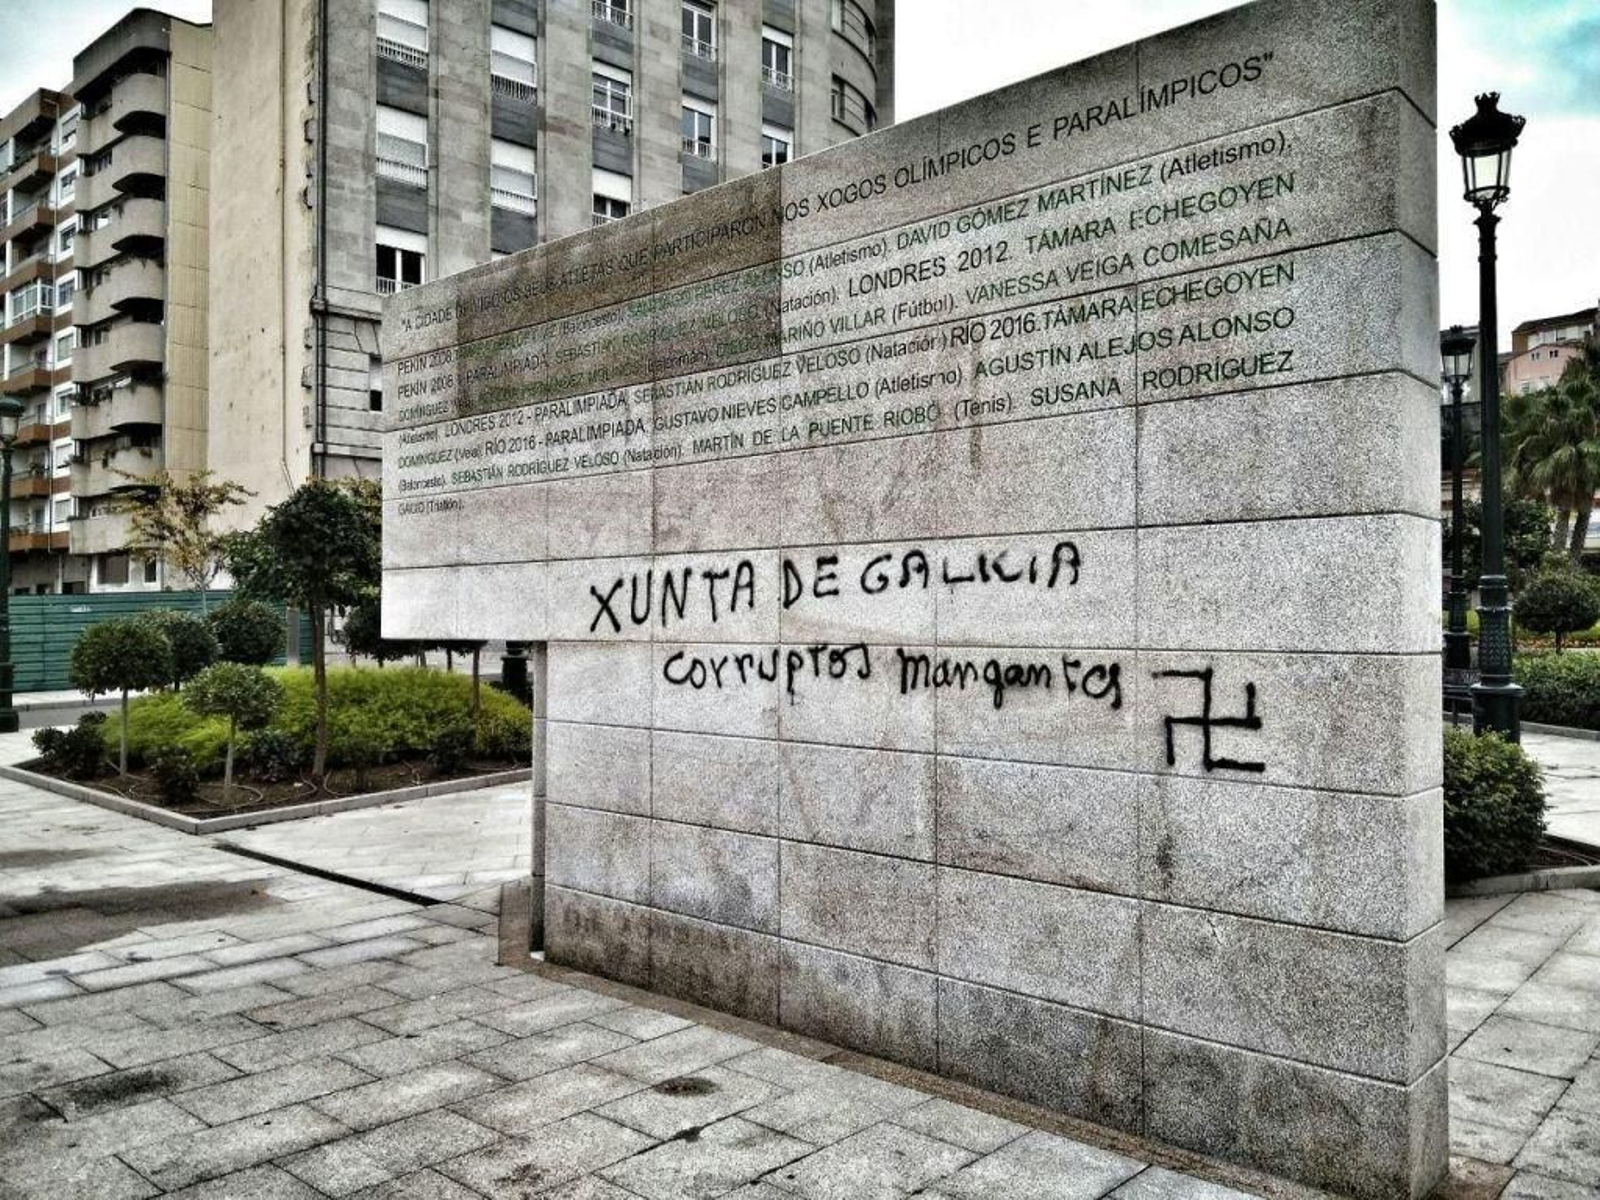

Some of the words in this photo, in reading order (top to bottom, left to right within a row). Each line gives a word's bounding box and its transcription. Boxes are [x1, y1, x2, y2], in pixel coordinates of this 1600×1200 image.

[415, 307, 452, 330] CIDADE
[619, 248, 649, 272] QUE
[652, 214, 767, 262] PARTICIPARON
[817, 174, 887, 213] XOGOS
[895, 133, 1016, 189] OLÍMPICOS
[1027, 124, 1042, 149] E
[848, 256, 946, 298] LONDRES
[1130, 171, 1296, 231] ECHEGOYEN
[897, 220, 951, 251] DAVID
[957, 198, 1030, 235] GÓMEZ
[1037, 164, 1153, 213] MARTÍNEZ
[1160, 130, 1292, 185] (Atletismo).
[830, 307, 886, 335] VILLAR
[893, 293, 959, 326] (Fútbol).
[966, 270, 1059, 305] VANESSA
[1066, 252, 1135, 283] VEIGA
[1143, 217, 1292, 267] COMESAÑA
[444, 415, 496, 438] LONDRES
[499, 410, 523, 429] 2012
[633, 377, 704, 404] SEBASTIÁN
[708, 361, 791, 391] RODRÍGUEZ
[795, 348, 861, 374] VELOSO
[951, 318, 986, 348] RÍO
[1141, 261, 1295, 311] ECHEGOYEN
[485, 436, 506, 457] RÍO
[508, 435, 536, 454] 2016
[654, 407, 719, 432] GUSTAVO
[722, 397, 777, 421] NIEVES
[782, 382, 870, 411] CAMPELLO
[974, 343, 1072, 380] AGUSTÍN
[1077, 328, 1173, 362] ALEJOS
[1178, 307, 1295, 346] ALONSO
[507, 456, 570, 478] RODRÍGUEZ
[574, 450, 620, 470] VELOSO
[693, 430, 744, 455] MARTÍN
[752, 429, 773, 447] DE
[781, 425, 800, 443] LA
[808, 413, 875, 439] PUENTE
[883, 400, 941, 428] RIOBÓ
[1030, 378, 1122, 408] SUSANA
[1143, 349, 1294, 391] RODRÍGUEZ
[589, 559, 755, 634] XUNTA
[782, 554, 841, 610] DE
